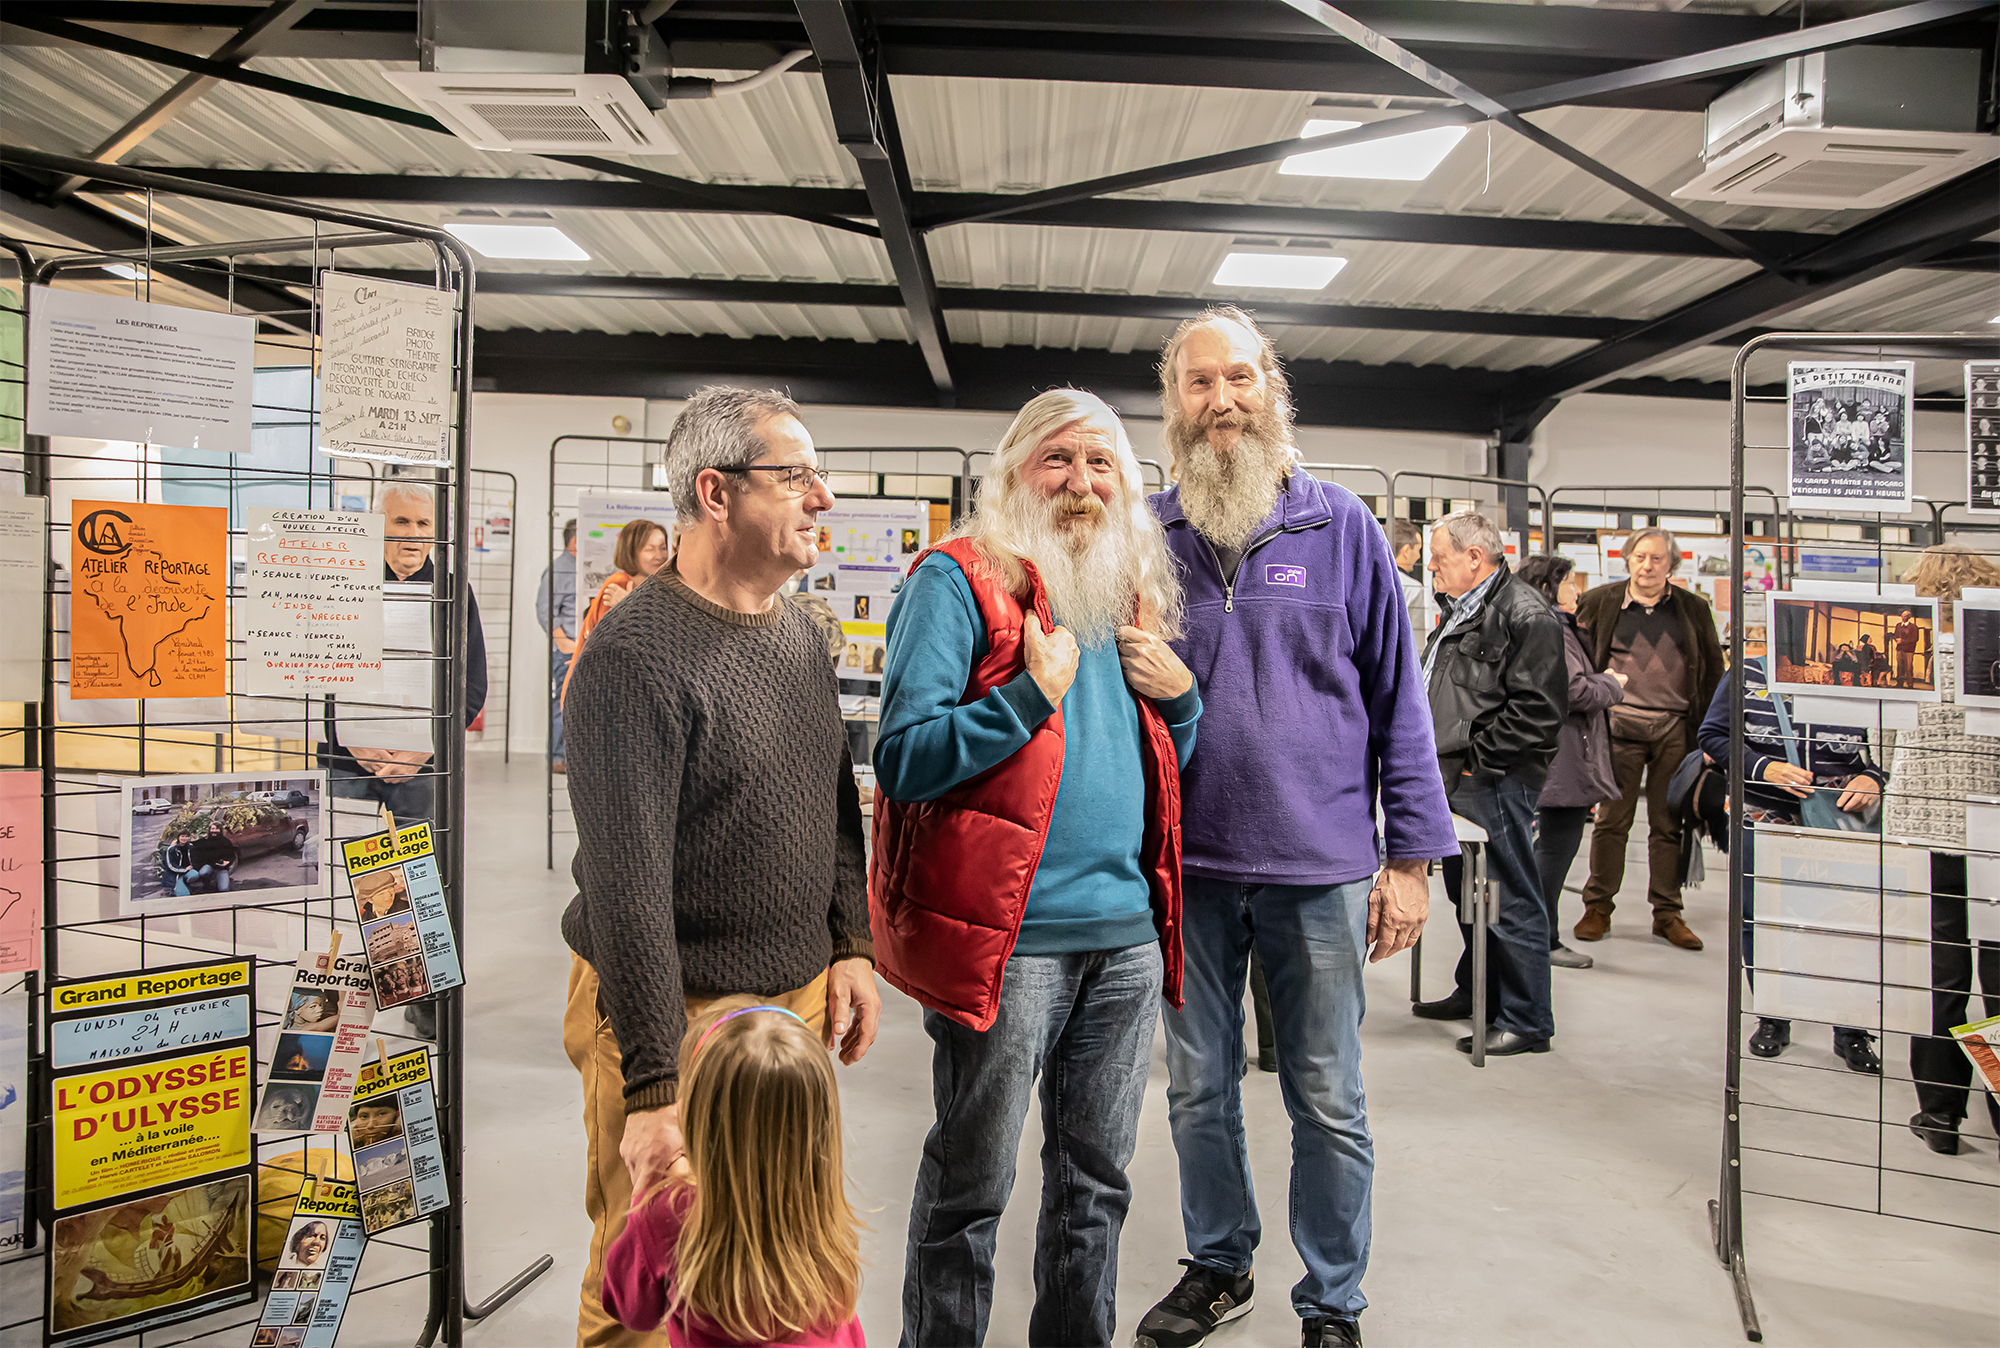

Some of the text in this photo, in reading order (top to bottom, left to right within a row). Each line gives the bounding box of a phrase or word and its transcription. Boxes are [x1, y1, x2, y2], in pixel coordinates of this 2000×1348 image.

[116, 318, 178, 333] LES REPORTAGES
[406, 327, 435, 341] BRIDGE
[406, 338, 433, 350] PHOTO
[351, 353, 385, 367] GUITARE
[406, 349, 441, 363] THEATRE
[331, 362, 428, 383] INFORMATIQUE ECHECS
[1794, 377, 1807, 385] LE
[1813, 373, 1845, 382] PETIT
[329, 373, 416, 393] DECOUVERTE DU CIEL
[325, 383, 362, 397] HISTOIRE
[364, 388, 375, 398] DE
[379, 391, 411, 402] NOGARO
[368, 406, 399, 421] MARDI
[403, 410, 416, 423] 13
[379, 421, 386, 429] A
[1844, 488, 1862, 496] JUIN
[272, 512, 325, 521] CREATION
[282, 523, 367, 534] NOUVEL ATELIER
[278, 538, 348, 550] ATELIER
[257, 552, 366, 567] REPORTAGES
[144, 559, 211, 576] REPORTAGE
[262, 570, 349, 581] SEANCE VENDREDI
[113, 575, 128, 594] la
[286, 593, 322, 601] MAISON
[326, 594, 336, 602] du
[338, 595, 364, 603] CLAN
[311, 613, 360, 621] NAEGELEN
[256, 629, 292, 638] SEANCE
[289, 652, 320, 660] MAISON
[324, 652, 333, 660] du
[337, 652, 362, 661] CLAN
[379, 826, 428, 849] Gand
[59, 970, 242, 1006] Grand Reportage
[74, 999, 232, 1034] LUNDI 04 FEVRIER
[131, 1020, 180, 1042] 21 H
[89, 1030, 223, 1060] MAISON du CLAN
[58, 1055, 247, 1112] L'ODYSSÉE
[73, 1087, 241, 1142] D'ULYSSE
[136, 1123, 194, 1144] à la voile
[90, 1156, 108, 1167] en
[119, 1163, 155, 1176] CARTELET
[187, 1148, 221, 1160] SALOMON
[333, 1186, 358, 1200] Gra
[298, 1196, 360, 1217] Reporta
